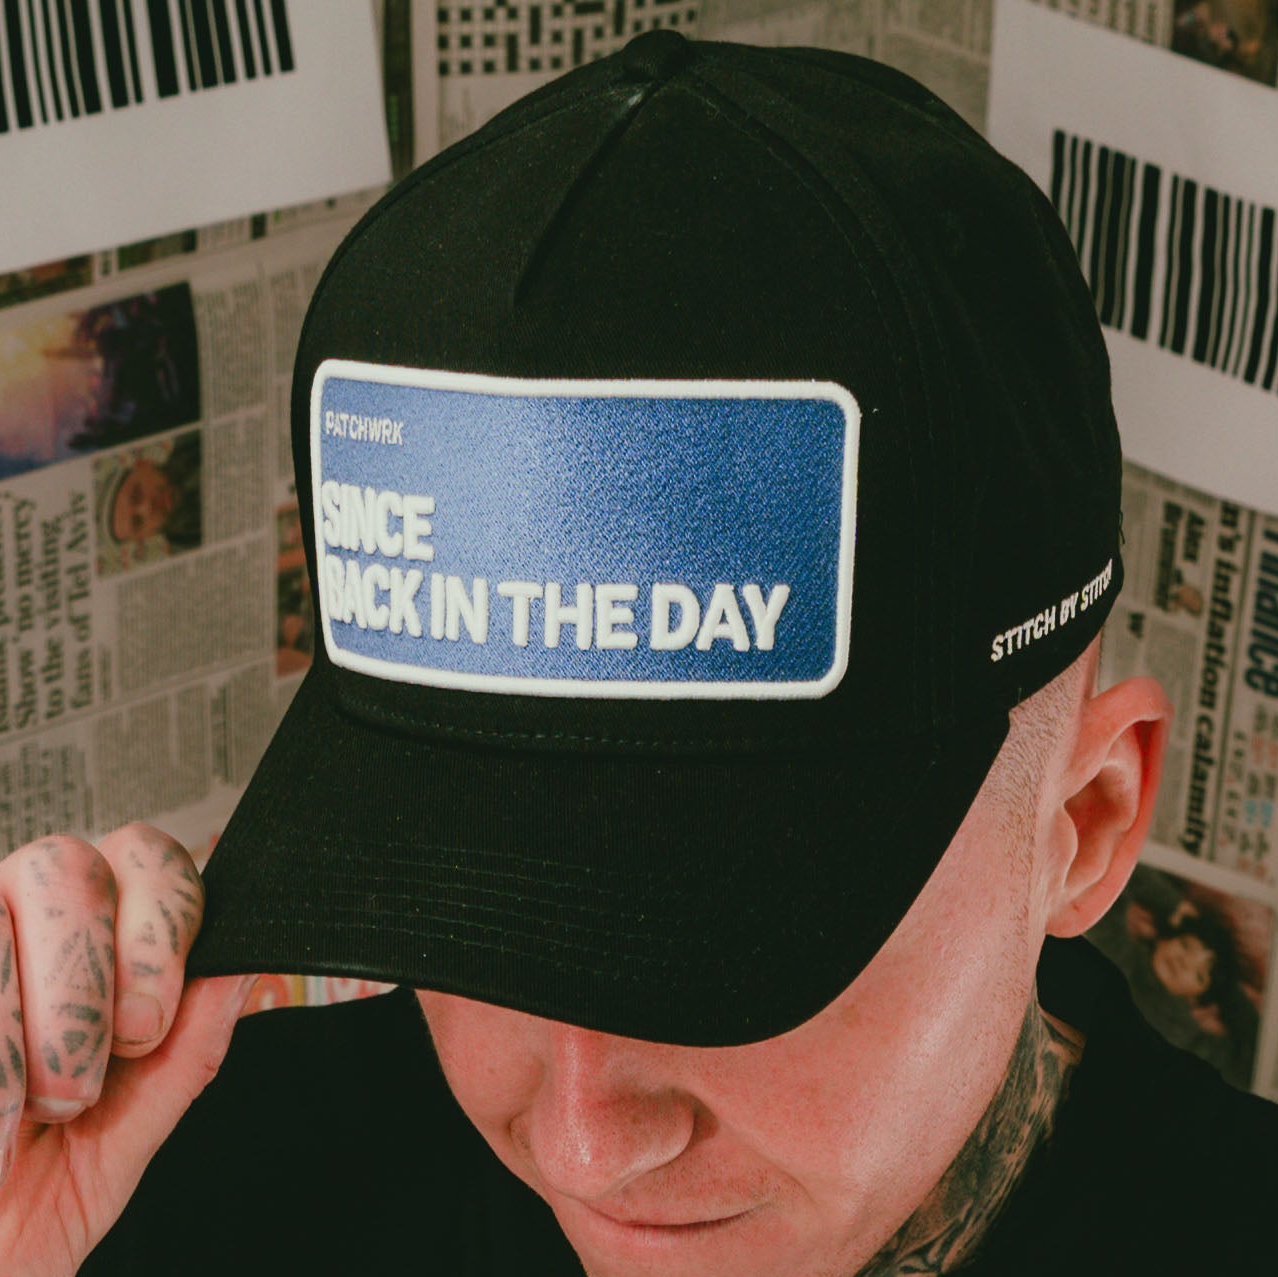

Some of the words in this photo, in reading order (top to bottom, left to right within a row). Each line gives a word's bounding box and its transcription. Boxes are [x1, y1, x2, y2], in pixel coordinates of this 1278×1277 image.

[324, 410, 404, 446] PATCHWRK
[321, 480, 436, 562] SINCE
[37, 518, 63, 628] visiting
[65, 563, 90, 608] Tel
[323, 554, 423, 639] BACK
[430, 572, 489, 645] IN
[496, 579, 639, 651] THE
[649, 581, 791, 652] DAY
[41, 638, 64, 683] the
[991, 605, 1056, 662] STITCH
[1060, 592, 1078, 626] BY
[1199, 558, 1237, 709] inflation
[13, 649, 36, 726] Show
[43, 688, 65, 718] to
[68, 647, 93, 709] fans
[1178, 714, 1214, 856] calamity
